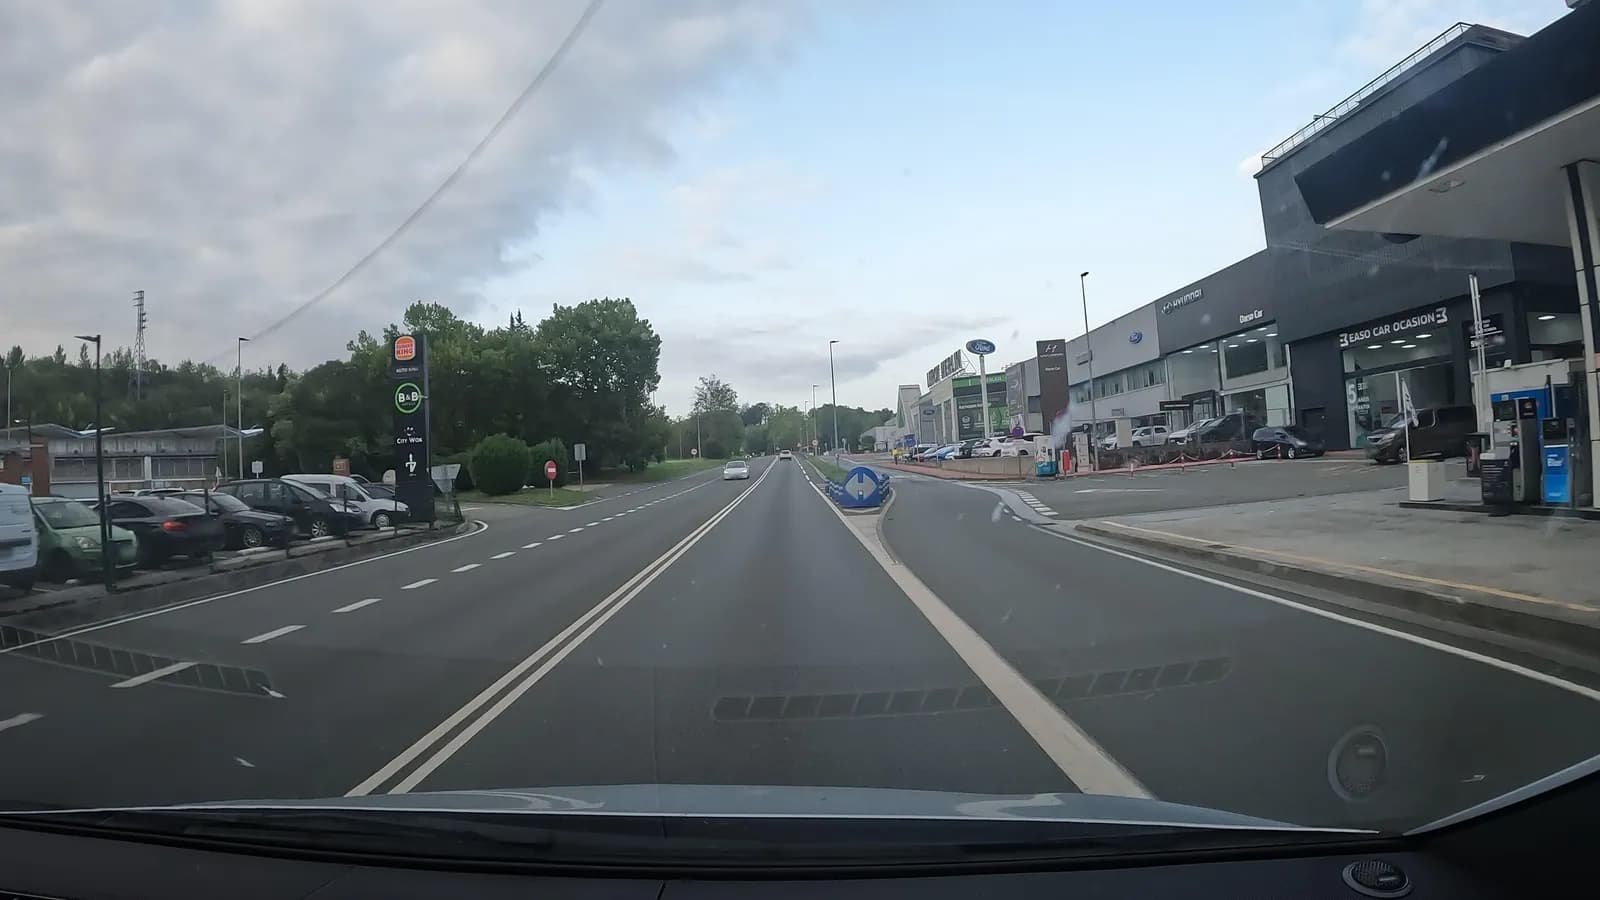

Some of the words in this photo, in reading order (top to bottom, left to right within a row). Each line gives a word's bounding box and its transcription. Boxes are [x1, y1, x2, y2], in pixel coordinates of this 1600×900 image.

[1348, 328, 1371, 343] EASO
[1372, 323, 1391, 337] CAR
[1392, 312, 1435, 332] OCASION
[1348, 383, 1357, 404] 5
